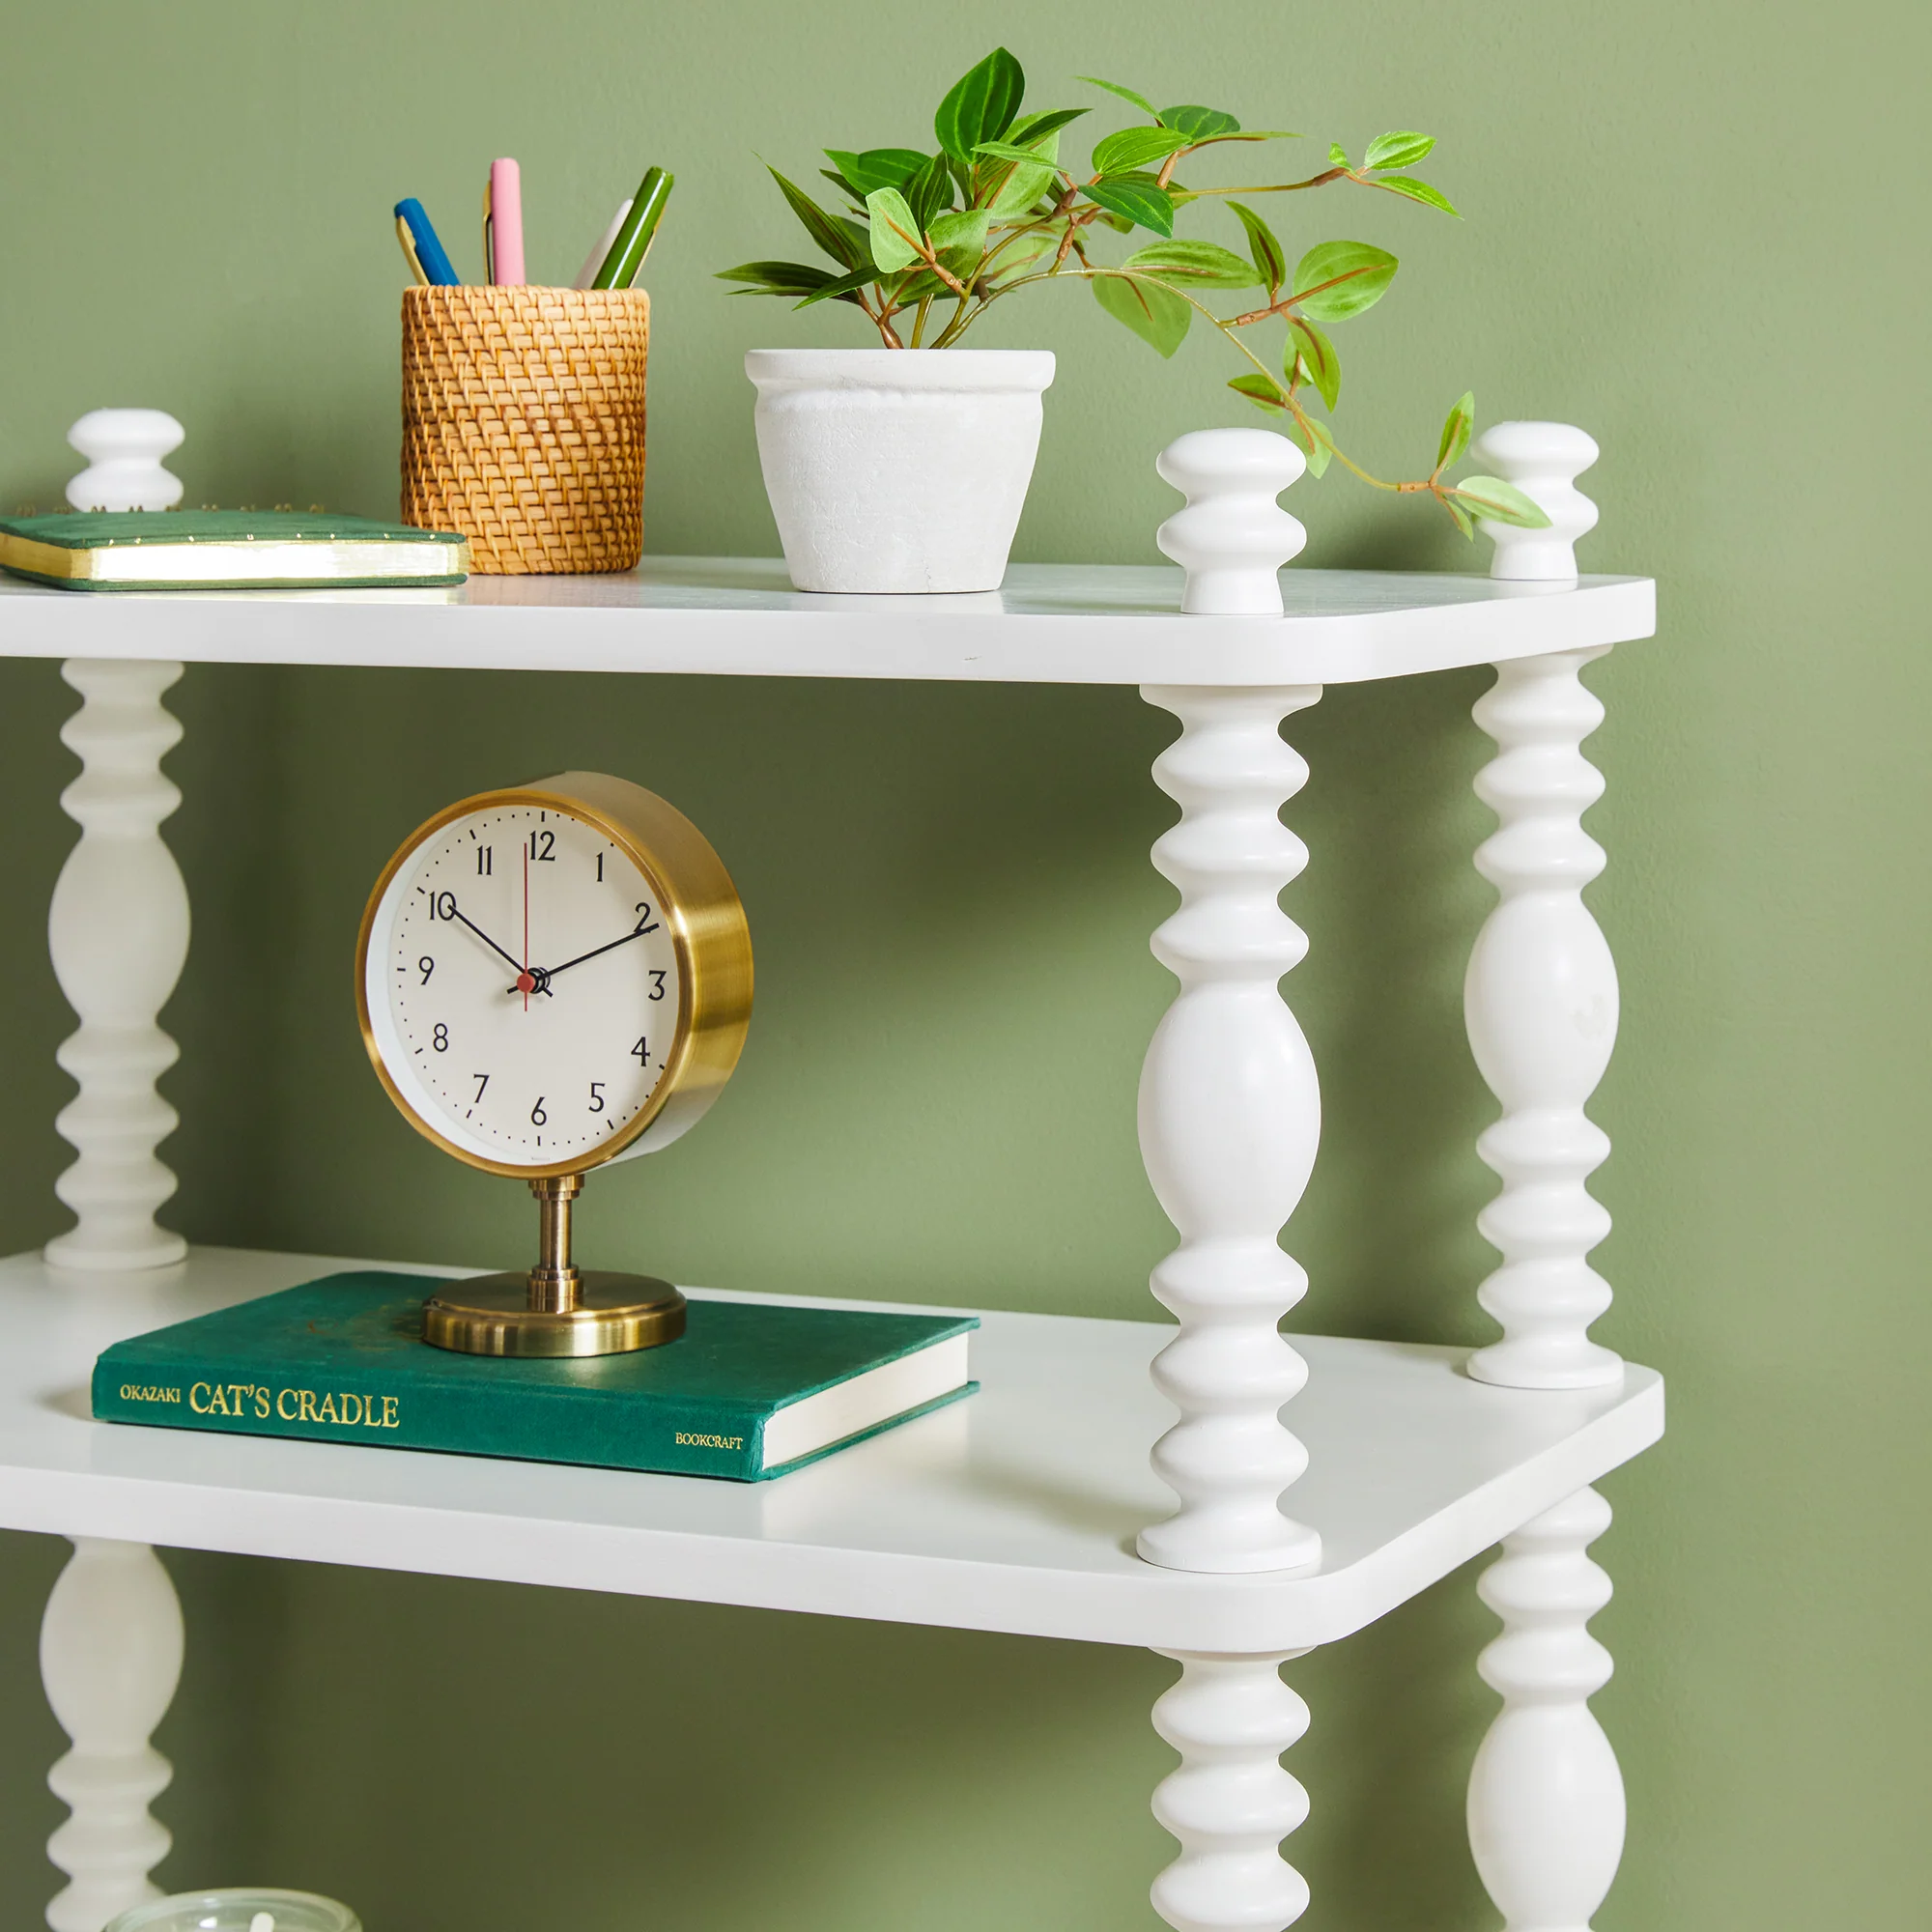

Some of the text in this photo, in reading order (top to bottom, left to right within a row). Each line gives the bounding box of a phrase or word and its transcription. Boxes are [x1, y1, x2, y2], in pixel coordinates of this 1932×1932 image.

[476, 845, 493, 875] 11
[529, 830, 555, 861] 12
[596, 851, 604, 882] 1
[429, 891, 456, 921] 10
[634, 902, 651, 933] 2
[418, 955, 435, 985] 9
[648, 970, 666, 1001] 3
[433, 1022, 449, 1053] 8
[631, 1037, 650, 1066] 4
[473, 1074, 490, 1103] 7
[588, 1082, 606, 1112] 5
[530, 1096, 548, 1125] 6
[120, 1381, 401, 1429] OKAZAKI CAT'S CRADLE
[675, 1432, 743, 1450] BOOKCRAFT
